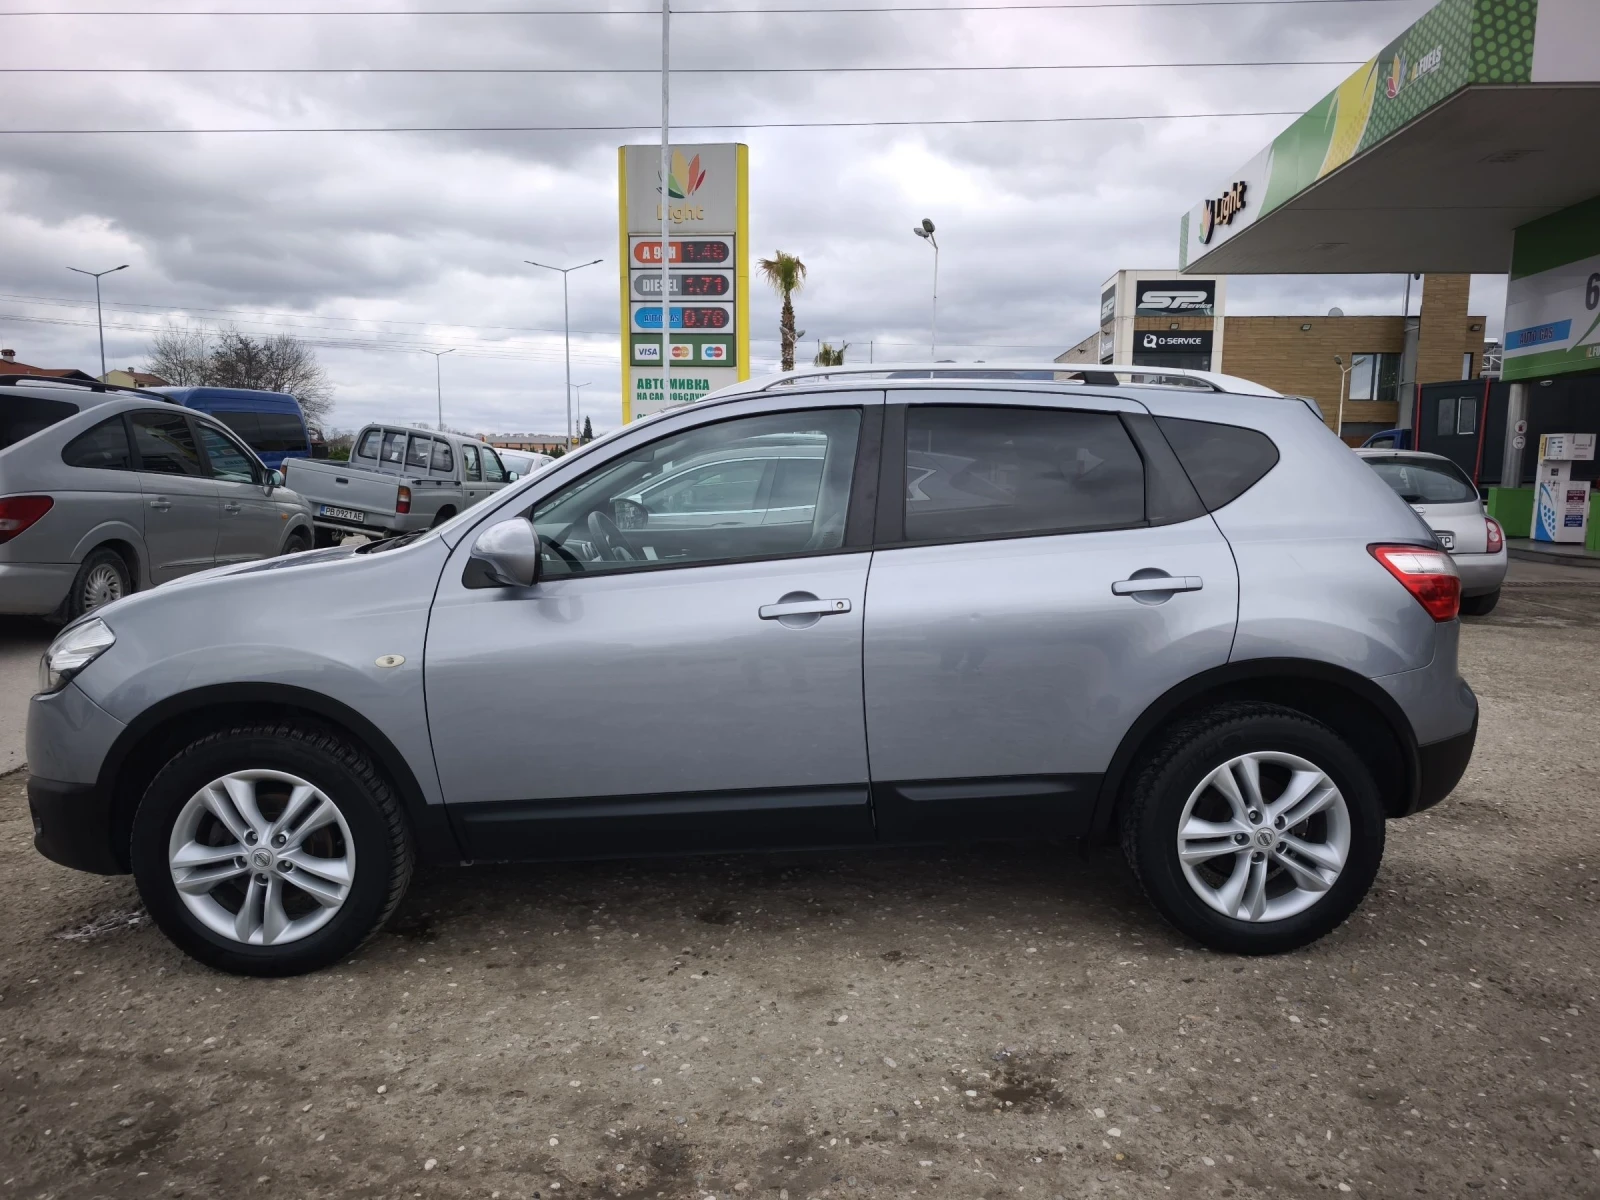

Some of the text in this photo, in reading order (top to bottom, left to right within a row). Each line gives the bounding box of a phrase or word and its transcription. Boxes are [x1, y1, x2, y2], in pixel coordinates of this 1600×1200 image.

[1214, 181, 1247, 225] Light
[656, 203, 704, 224] Light
[686, 277, 722, 292] 1.71
[1585, 272, 1600, 310] 6
[1137, 291, 1208, 309] SP
[1520, 327, 1554, 345] AUTO GAS
[638, 348, 658, 356] VISA
[637, 392, 647, 401] НА
